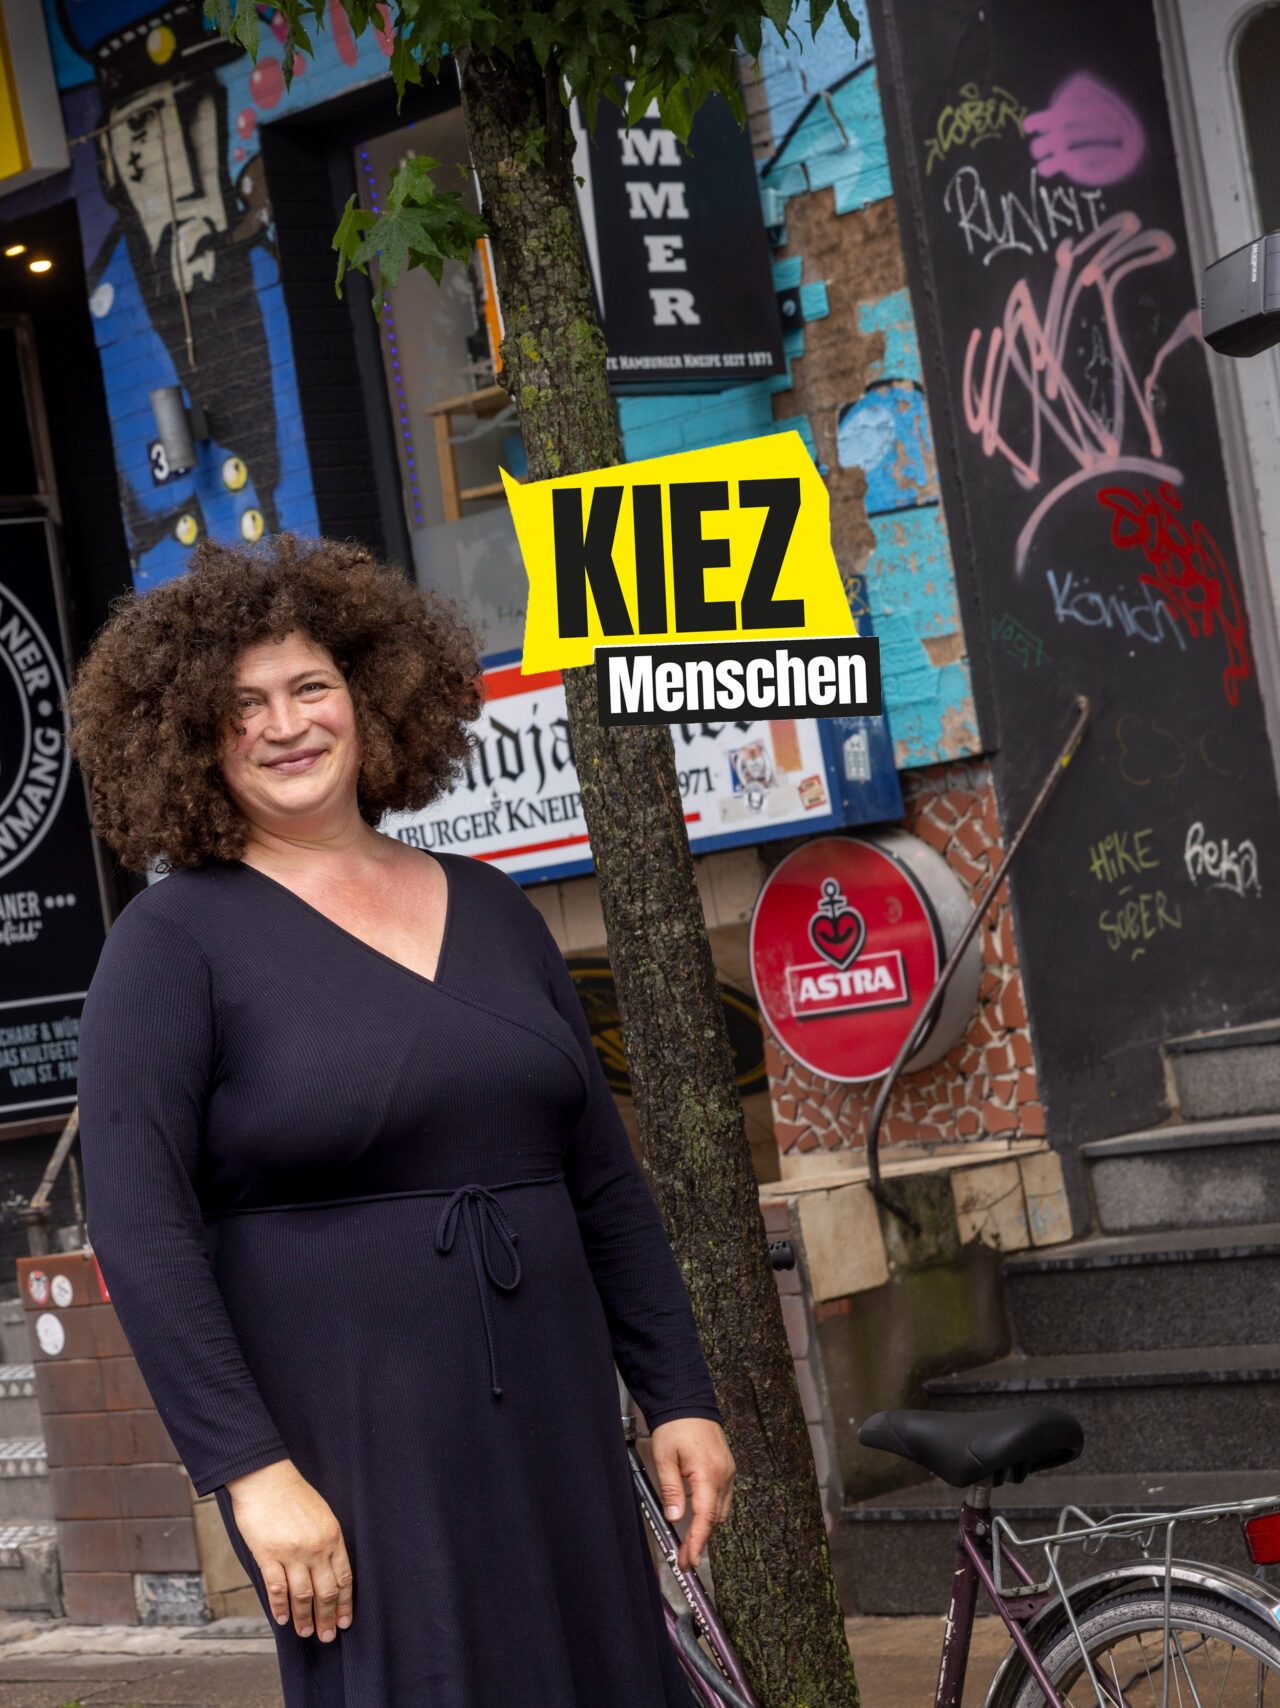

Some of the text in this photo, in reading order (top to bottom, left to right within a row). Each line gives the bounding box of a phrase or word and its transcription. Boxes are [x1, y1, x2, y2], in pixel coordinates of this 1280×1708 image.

[677, 766, 716, 798] 971
[507, 794, 581, 834] KNEIP
[799, 965, 896, 1003] ASTRA
[39, 1021, 53, 1042] &
[9, 1066, 38, 1088] VON
